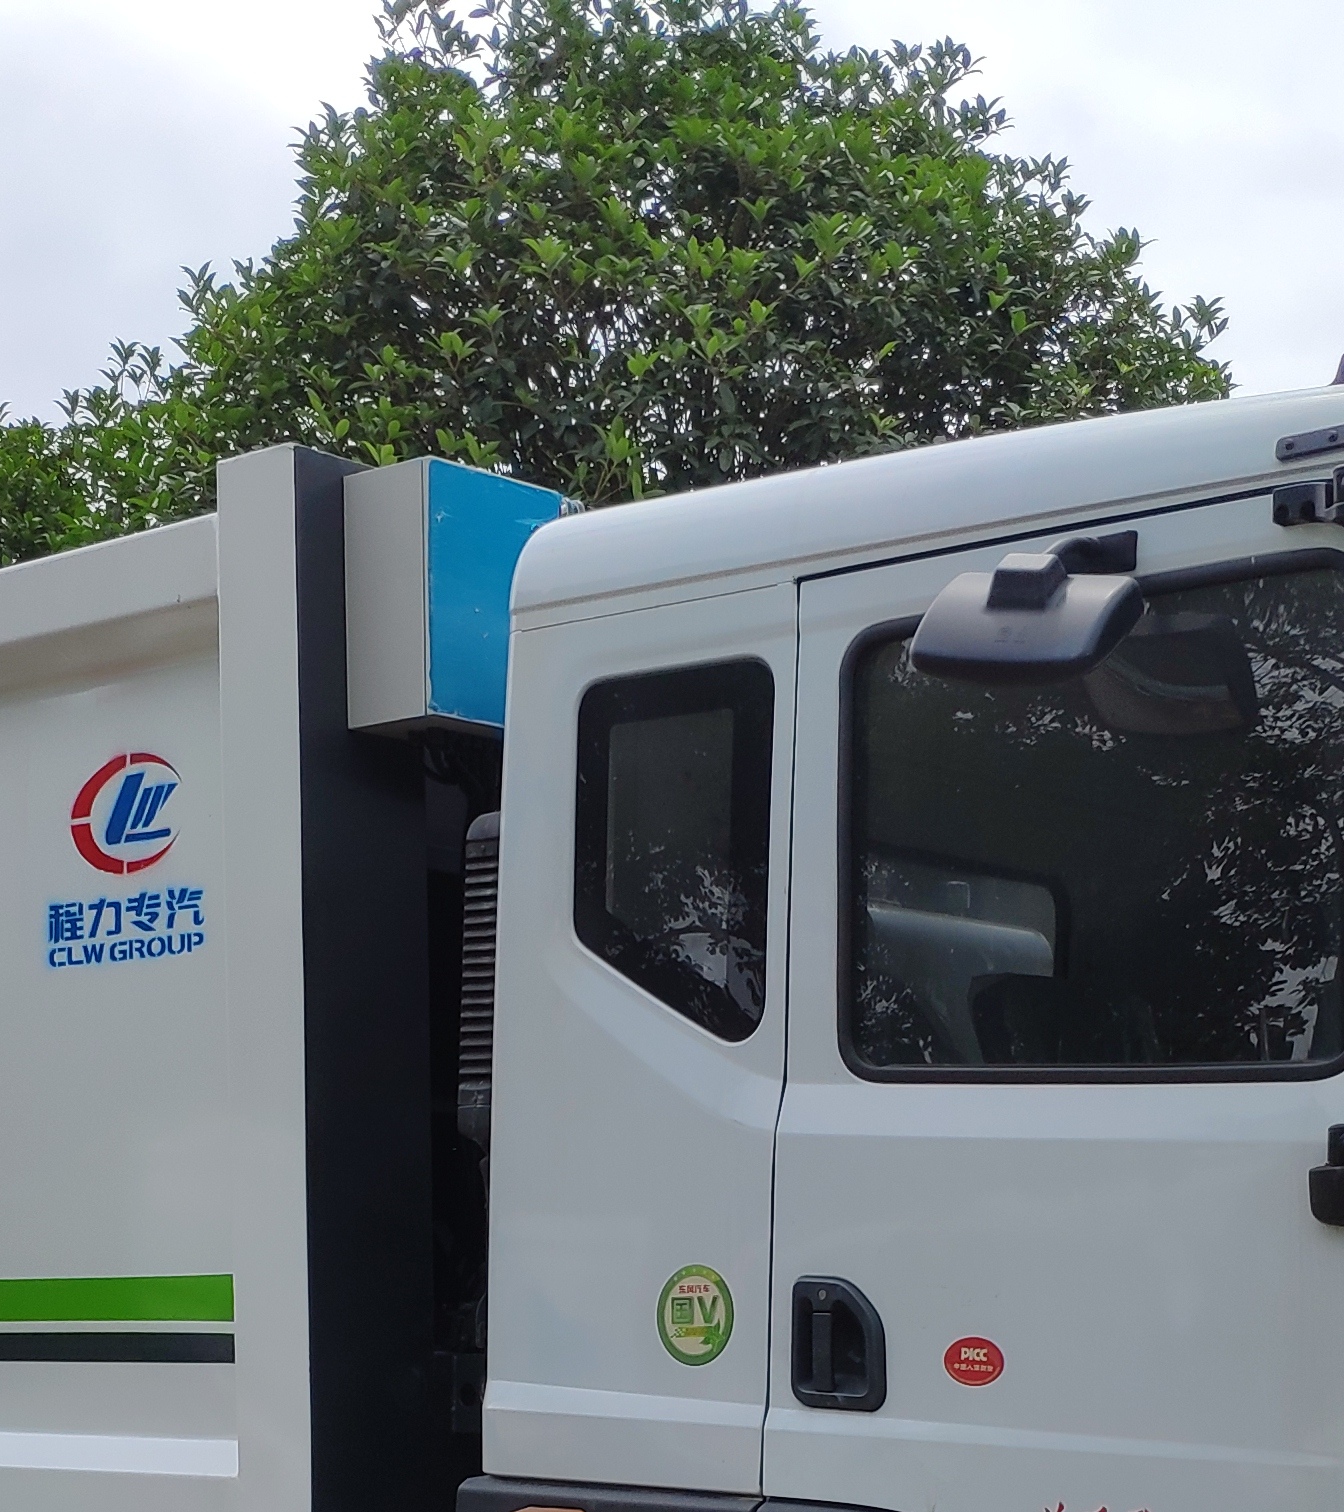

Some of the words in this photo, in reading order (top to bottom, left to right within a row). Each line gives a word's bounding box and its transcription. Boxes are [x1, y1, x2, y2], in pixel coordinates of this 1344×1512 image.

[48, 887, 205, 945] 程力专汽
[49, 942, 106, 968] CLW
[109, 931, 204, 962] GROUP
[960, 1347, 988, 1362] PICC
